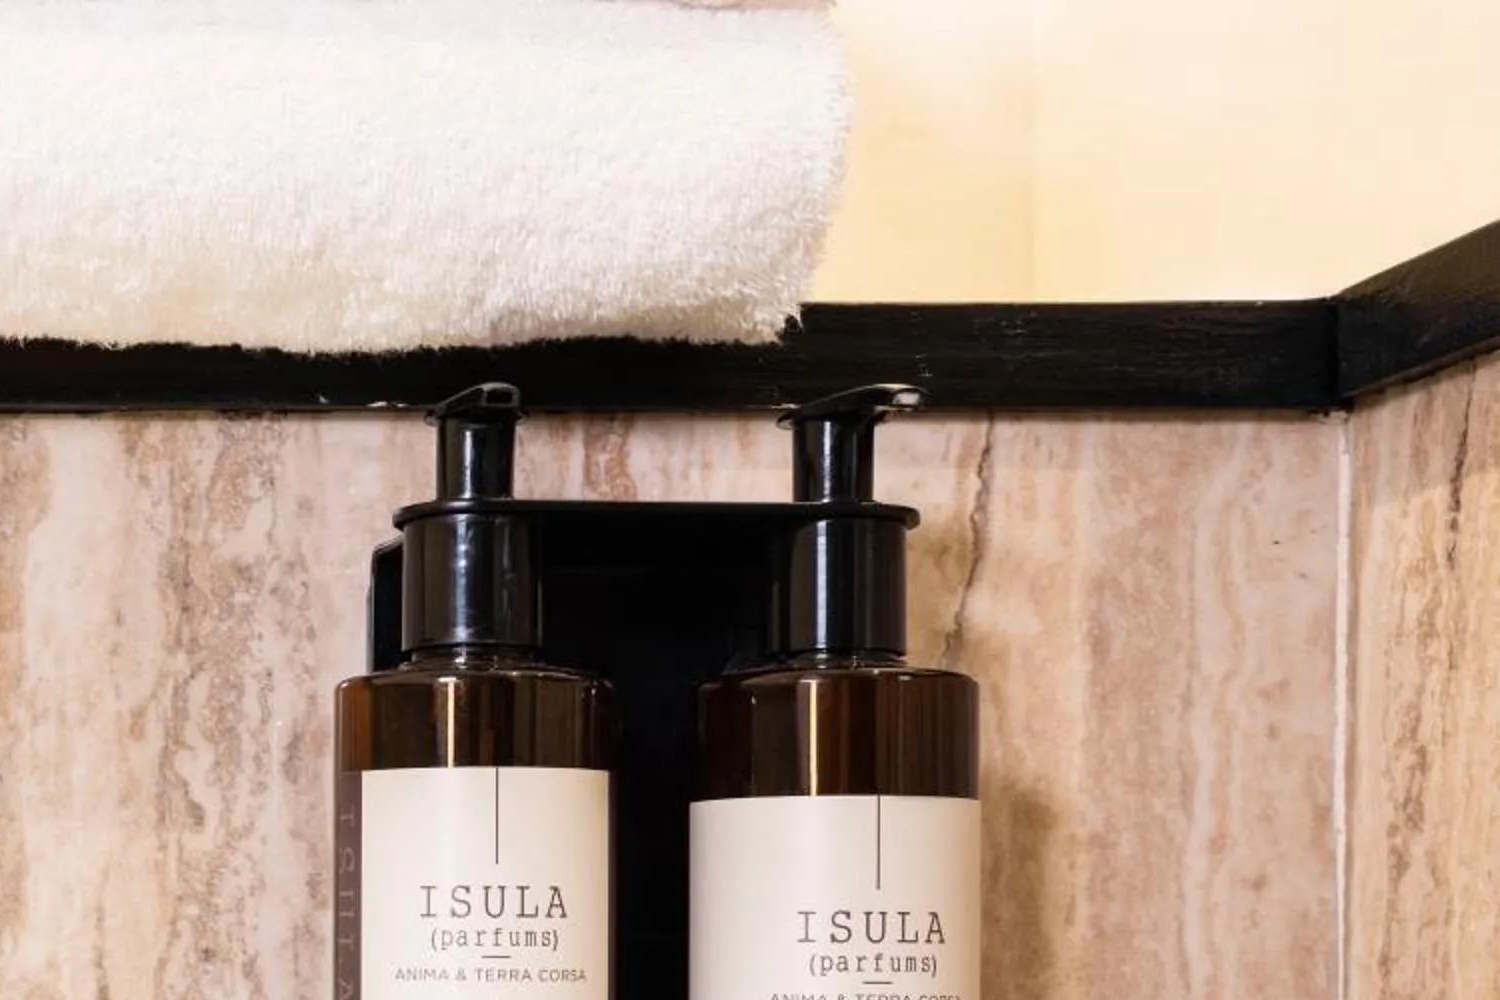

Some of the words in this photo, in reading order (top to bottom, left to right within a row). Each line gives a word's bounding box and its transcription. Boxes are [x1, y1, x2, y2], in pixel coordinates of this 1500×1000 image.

[419, 885, 568, 919] ISULA
[431, 928, 559, 951] (parfums)
[796, 910, 946, 945] ISULA
[395, 969, 448, 982] ANIMA
[455, 969, 466, 982] &
[474, 969, 532, 982] TERRA
[538, 969, 587, 982] CORSA
[809, 953, 937, 978] (parfums)
